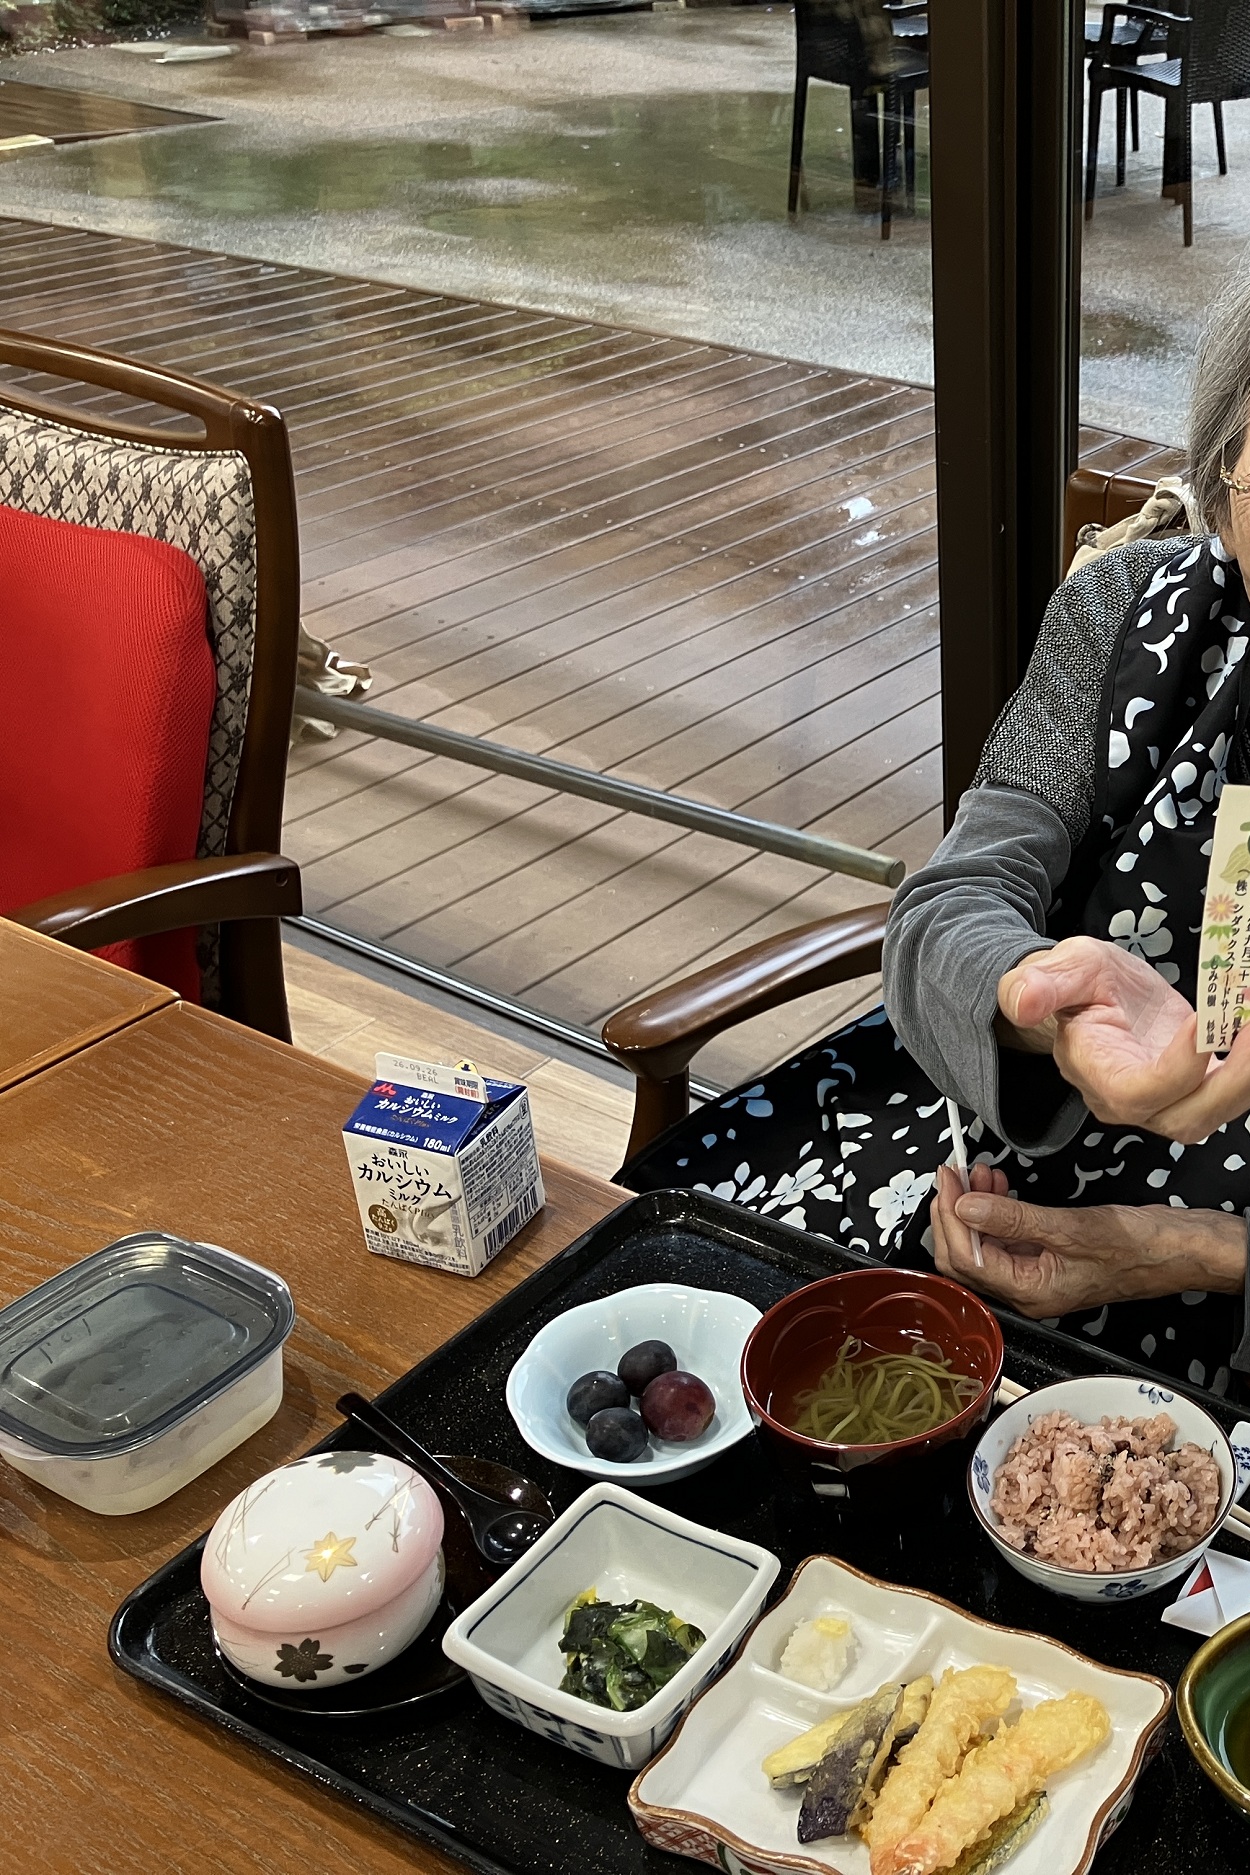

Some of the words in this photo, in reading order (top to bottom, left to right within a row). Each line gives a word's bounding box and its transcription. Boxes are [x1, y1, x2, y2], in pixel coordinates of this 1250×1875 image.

[393, 1060, 438, 1077] 26.09.26
[403, 1095, 441, 1109] おいしい
[423, 1137, 452, 1153] 180ml
[371, 1153, 430, 1176] おいしい
[357, 1163, 453, 1200] カルシウム
[388, 1187, 422, 1206] ミルク
